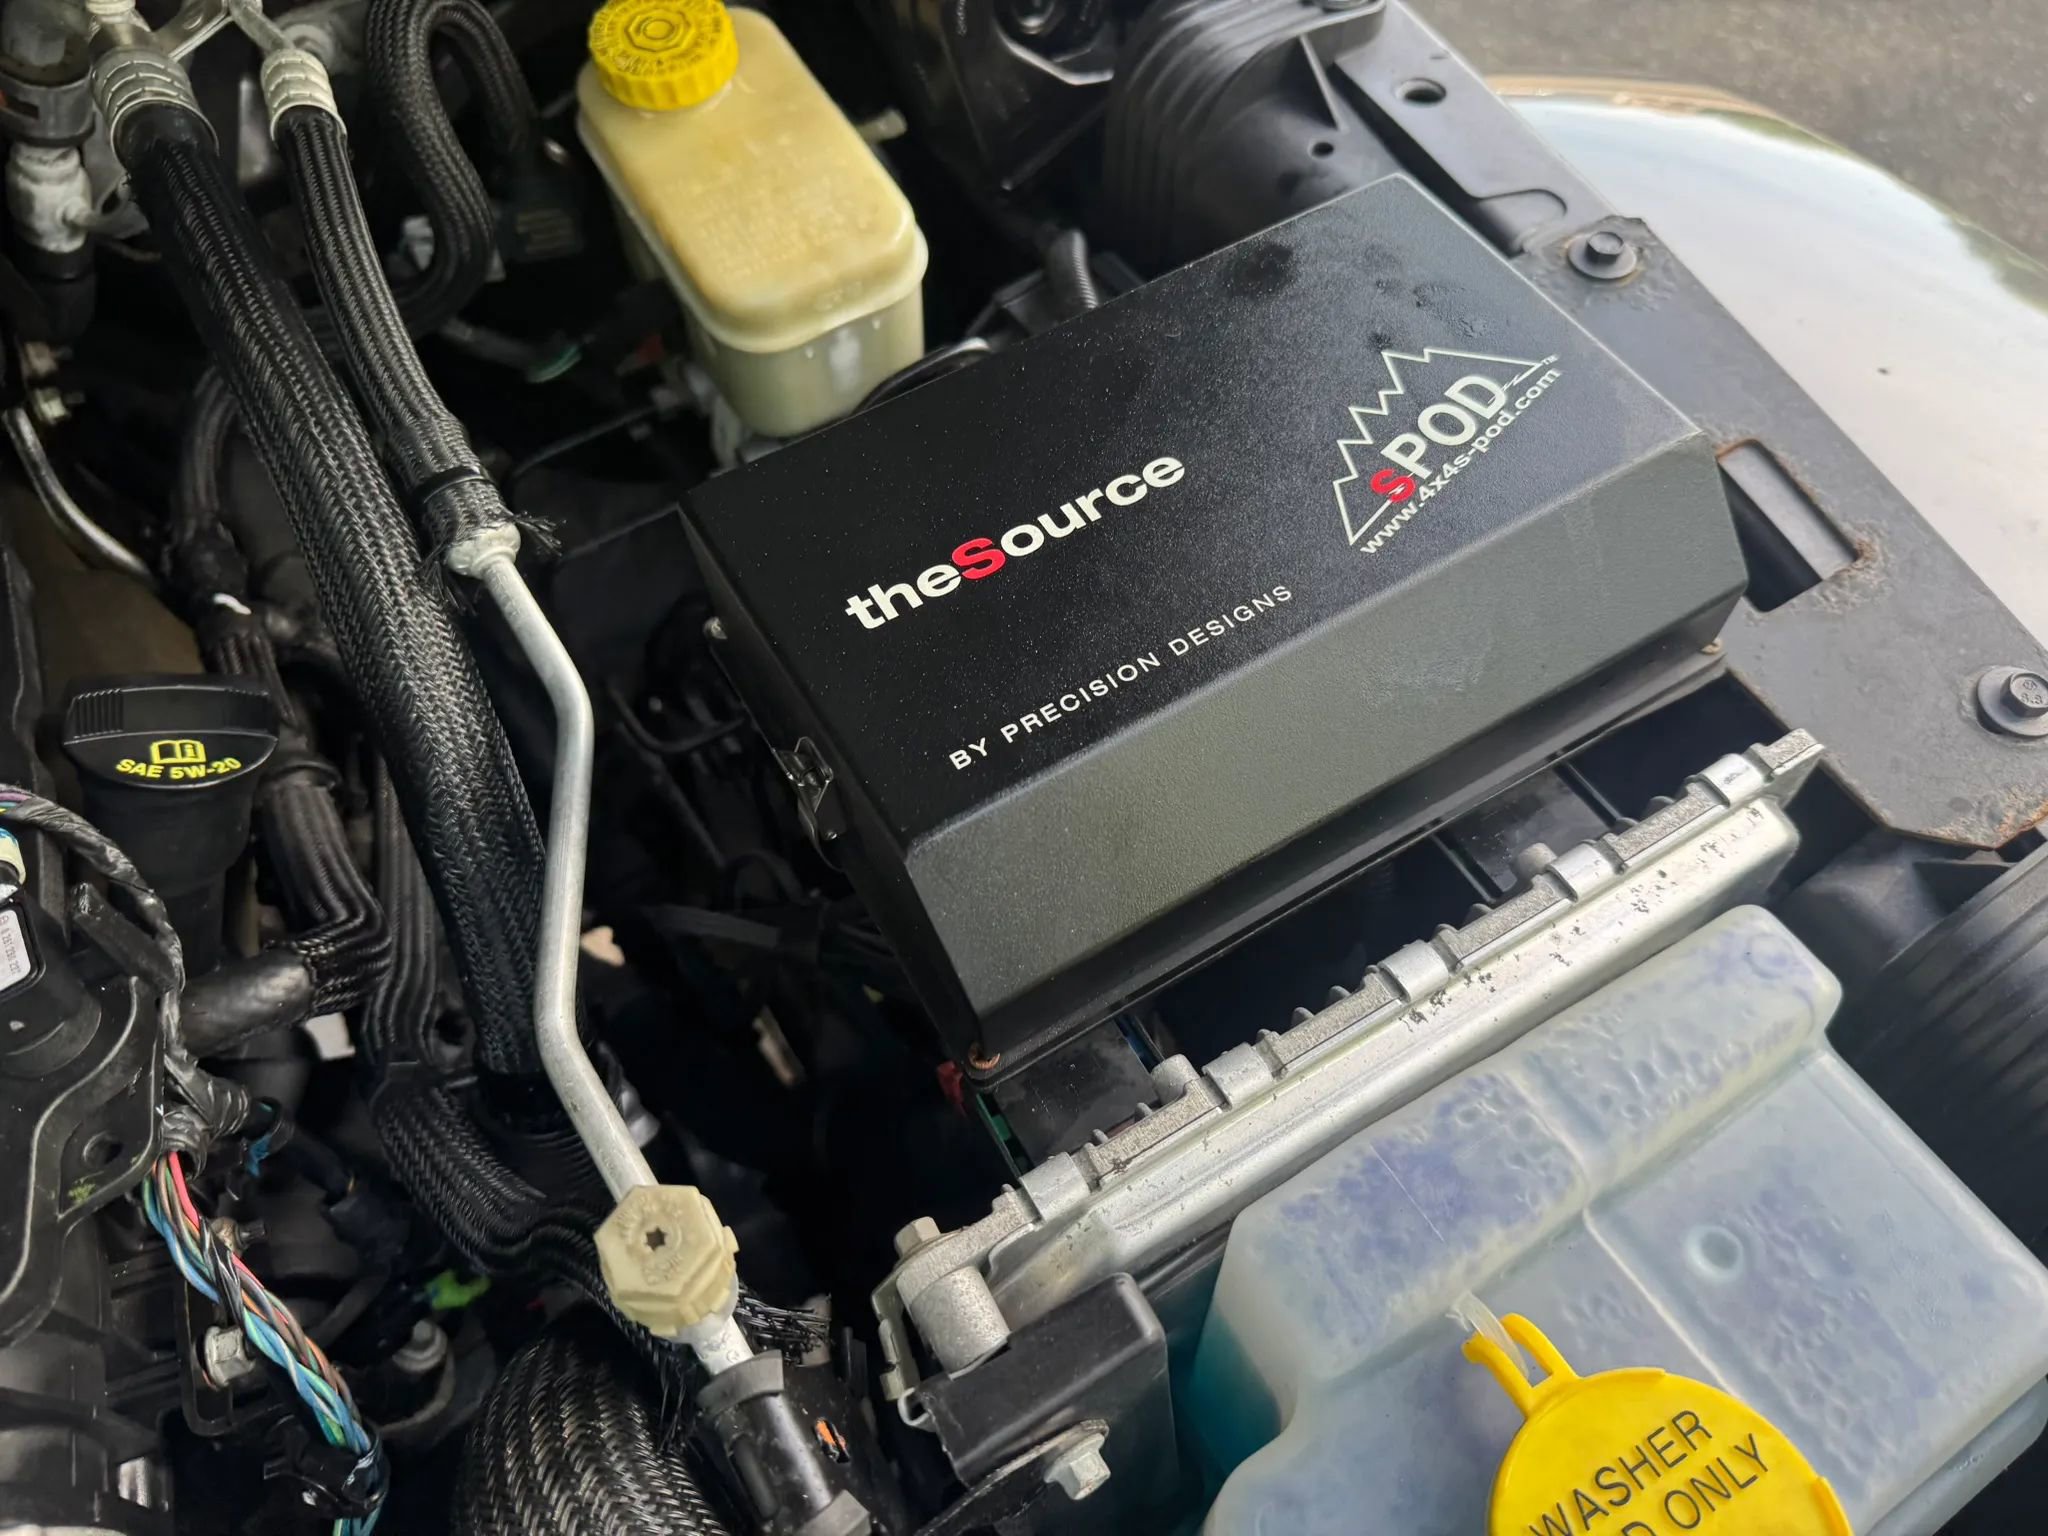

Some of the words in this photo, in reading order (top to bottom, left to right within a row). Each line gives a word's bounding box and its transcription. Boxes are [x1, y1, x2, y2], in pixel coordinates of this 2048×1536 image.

[1360, 369, 1561, 554] www.4x4s-pod.com
[845, 456, 1185, 630] theSource
[949, 737, 988, 770] BY
[1001, 652, 1160, 743] PRECISION
[1167, 585, 1292, 656] DESIGNS
[116, 758, 164, 779] SAE
[169, 757, 242, 780] 5W-20
[1529, 1410, 1712, 1536] WASHER
[1664, 1433, 1768, 1529] ONLY
